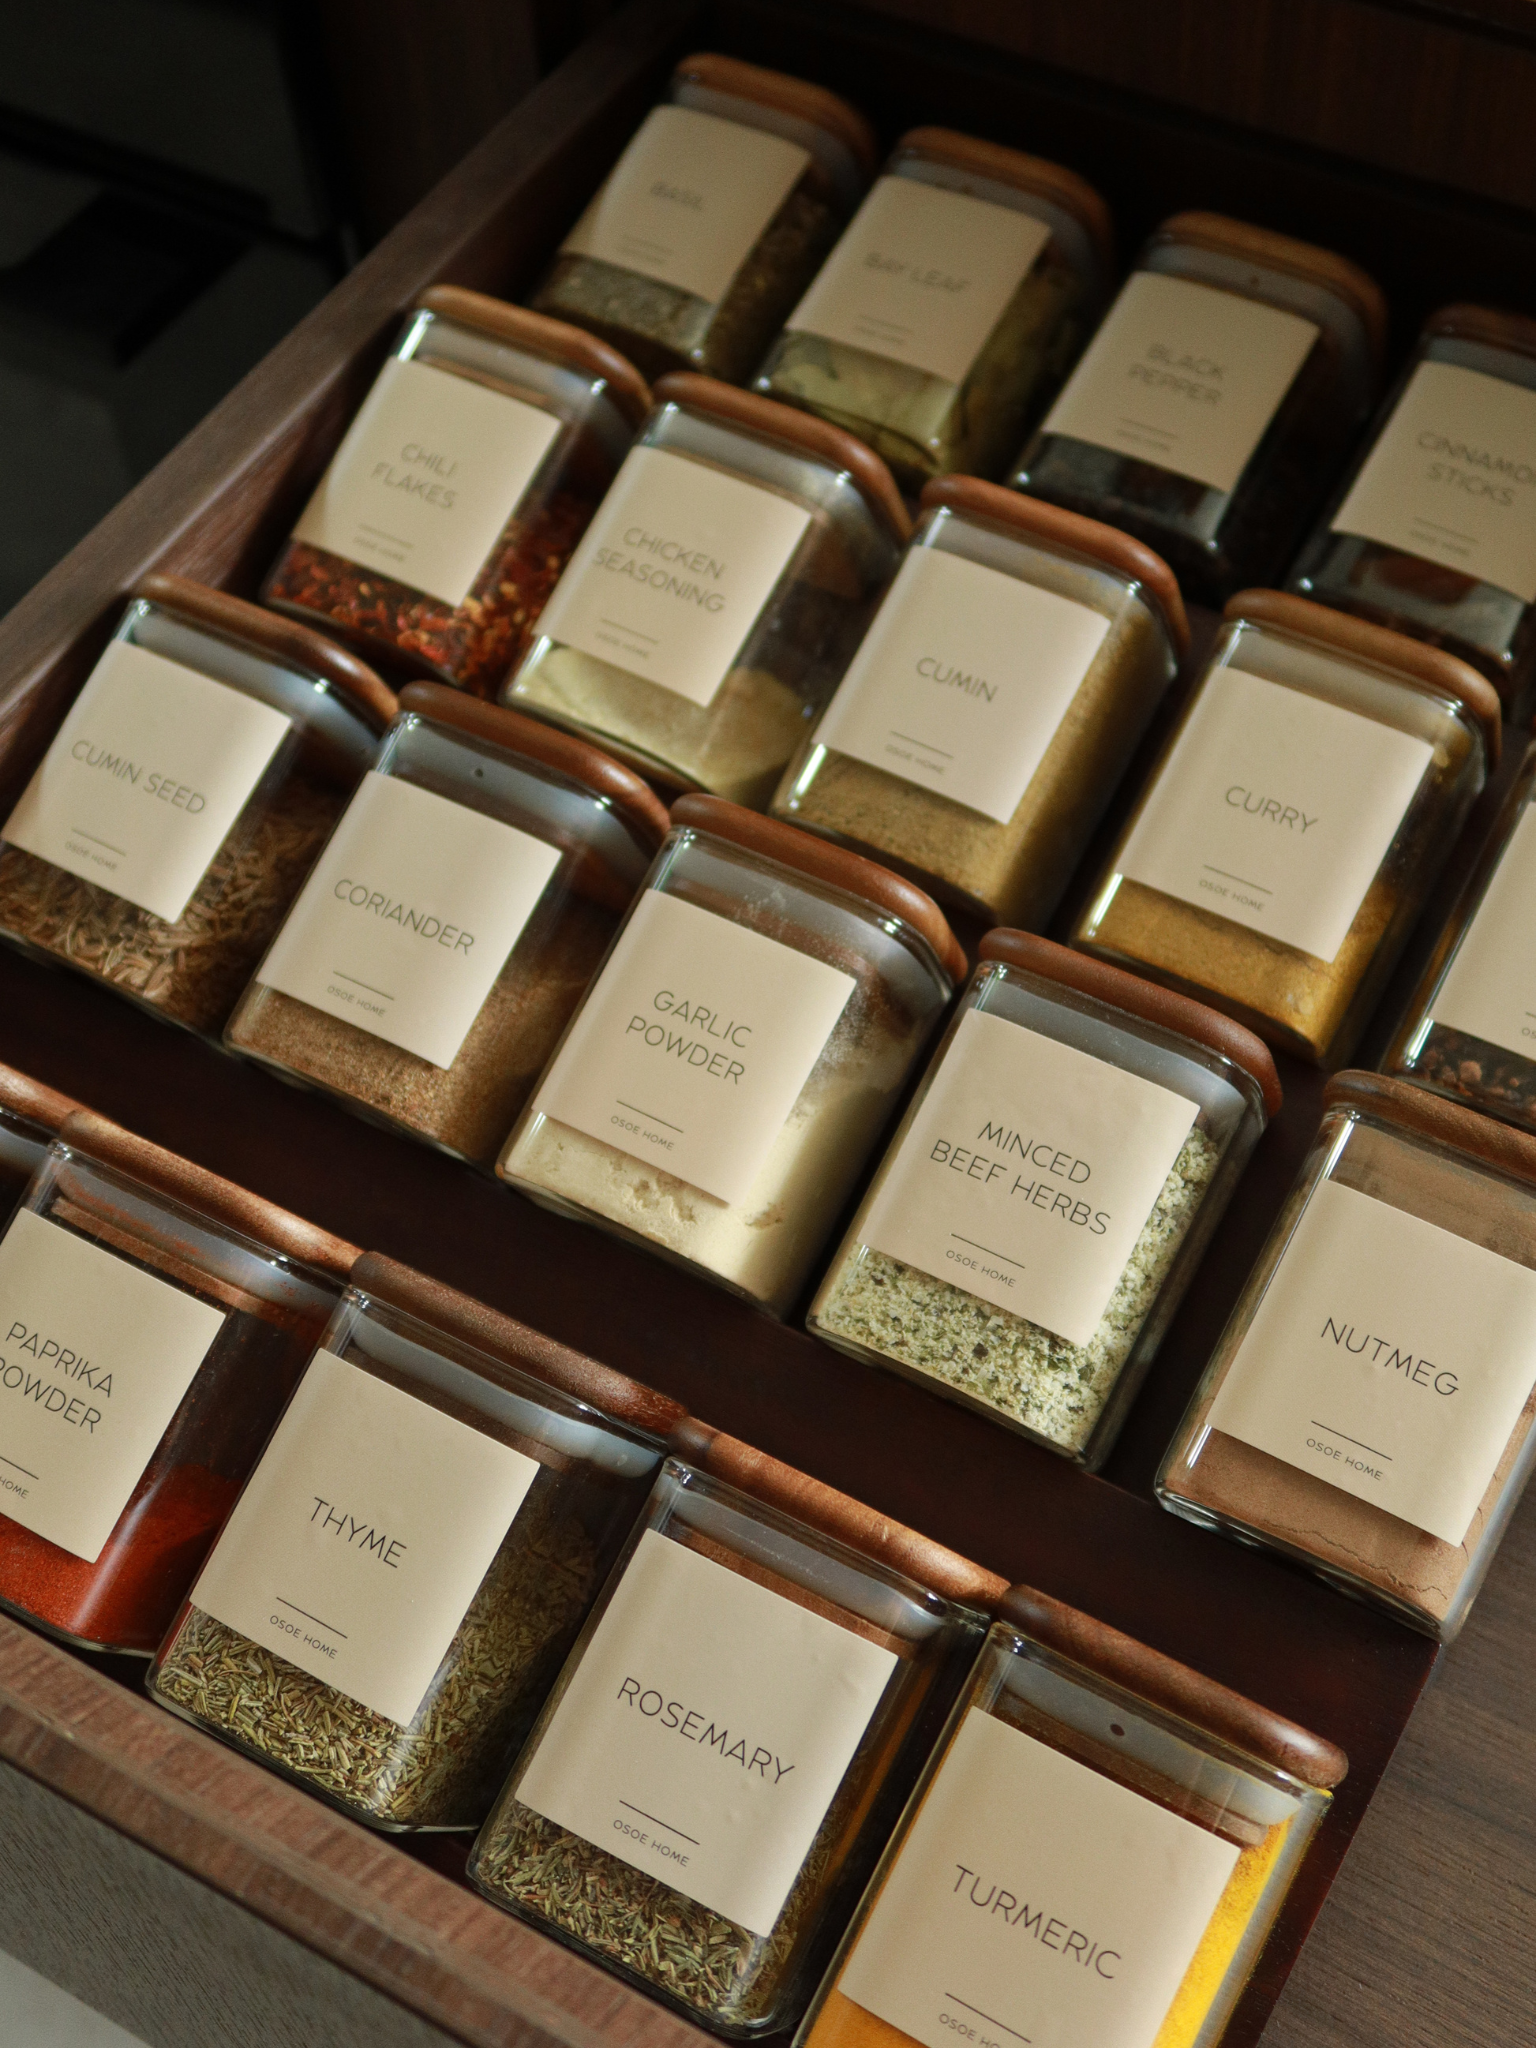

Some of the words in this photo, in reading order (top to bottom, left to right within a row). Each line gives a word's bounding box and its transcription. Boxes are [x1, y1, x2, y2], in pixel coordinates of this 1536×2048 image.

[1127, 366, 1222, 405] PEPPER
[1147, 343, 1224, 381] BLACK
[400, 443, 459, 477] CHILI
[1417, 431, 1536, 486] CINNAMO
[371, 461, 458, 510] FLAKES
[1427, 461, 1516, 507] STICKS
[622, 527, 726, 580] CHICKEN
[594, 548, 726, 613] SEASONING
[916, 657, 998, 703] CUMIN
[70, 740, 142, 785] CUMIN
[144, 772, 207, 814] SEED
[1225, 785, 1319, 834] CURRY
[333, 878, 475, 956] CORIANDER
[1199, 879, 1231, 901] OSOE
[1231, 892, 1266, 912] HOME
[327, 984, 355, 1005] OSOE
[356, 998, 386, 1017] HOME
[653, 990, 752, 1049] GARLIC
[626, 1015, 745, 1086] POWDER
[610, 1115, 640, 1138] OSOE
[642, 1129, 675, 1151] HOME
[977, 1121, 1091, 1186] MINCED
[929, 1139, 1008, 1184] BEEF
[1010, 1174, 1112, 1236] HERBS
[945, 1249, 979, 1272] OSOE
[981, 1263, 1017, 1288] HOME
[5, 1321, 113, 1399] PAPRIKA
[1320, 1316, 1460, 1397] NUTMEG
[1305, 1437, 1342, 1462] OSOE
[1344, 1455, 1384, 1481] HOME
[310, 1496, 408, 1570] THYME
[269, 1614, 303, 1640] OSOE
[303, 1632, 339, 1660] HOME
[616, 1676, 796, 1786] ROSEMARY
[612, 1818, 649, 1846] OSOE
[650, 1839, 691, 1867] HOME
[952, 1863, 1123, 1981] TURMERIC
[938, 2012, 977, 2041] OSOE
